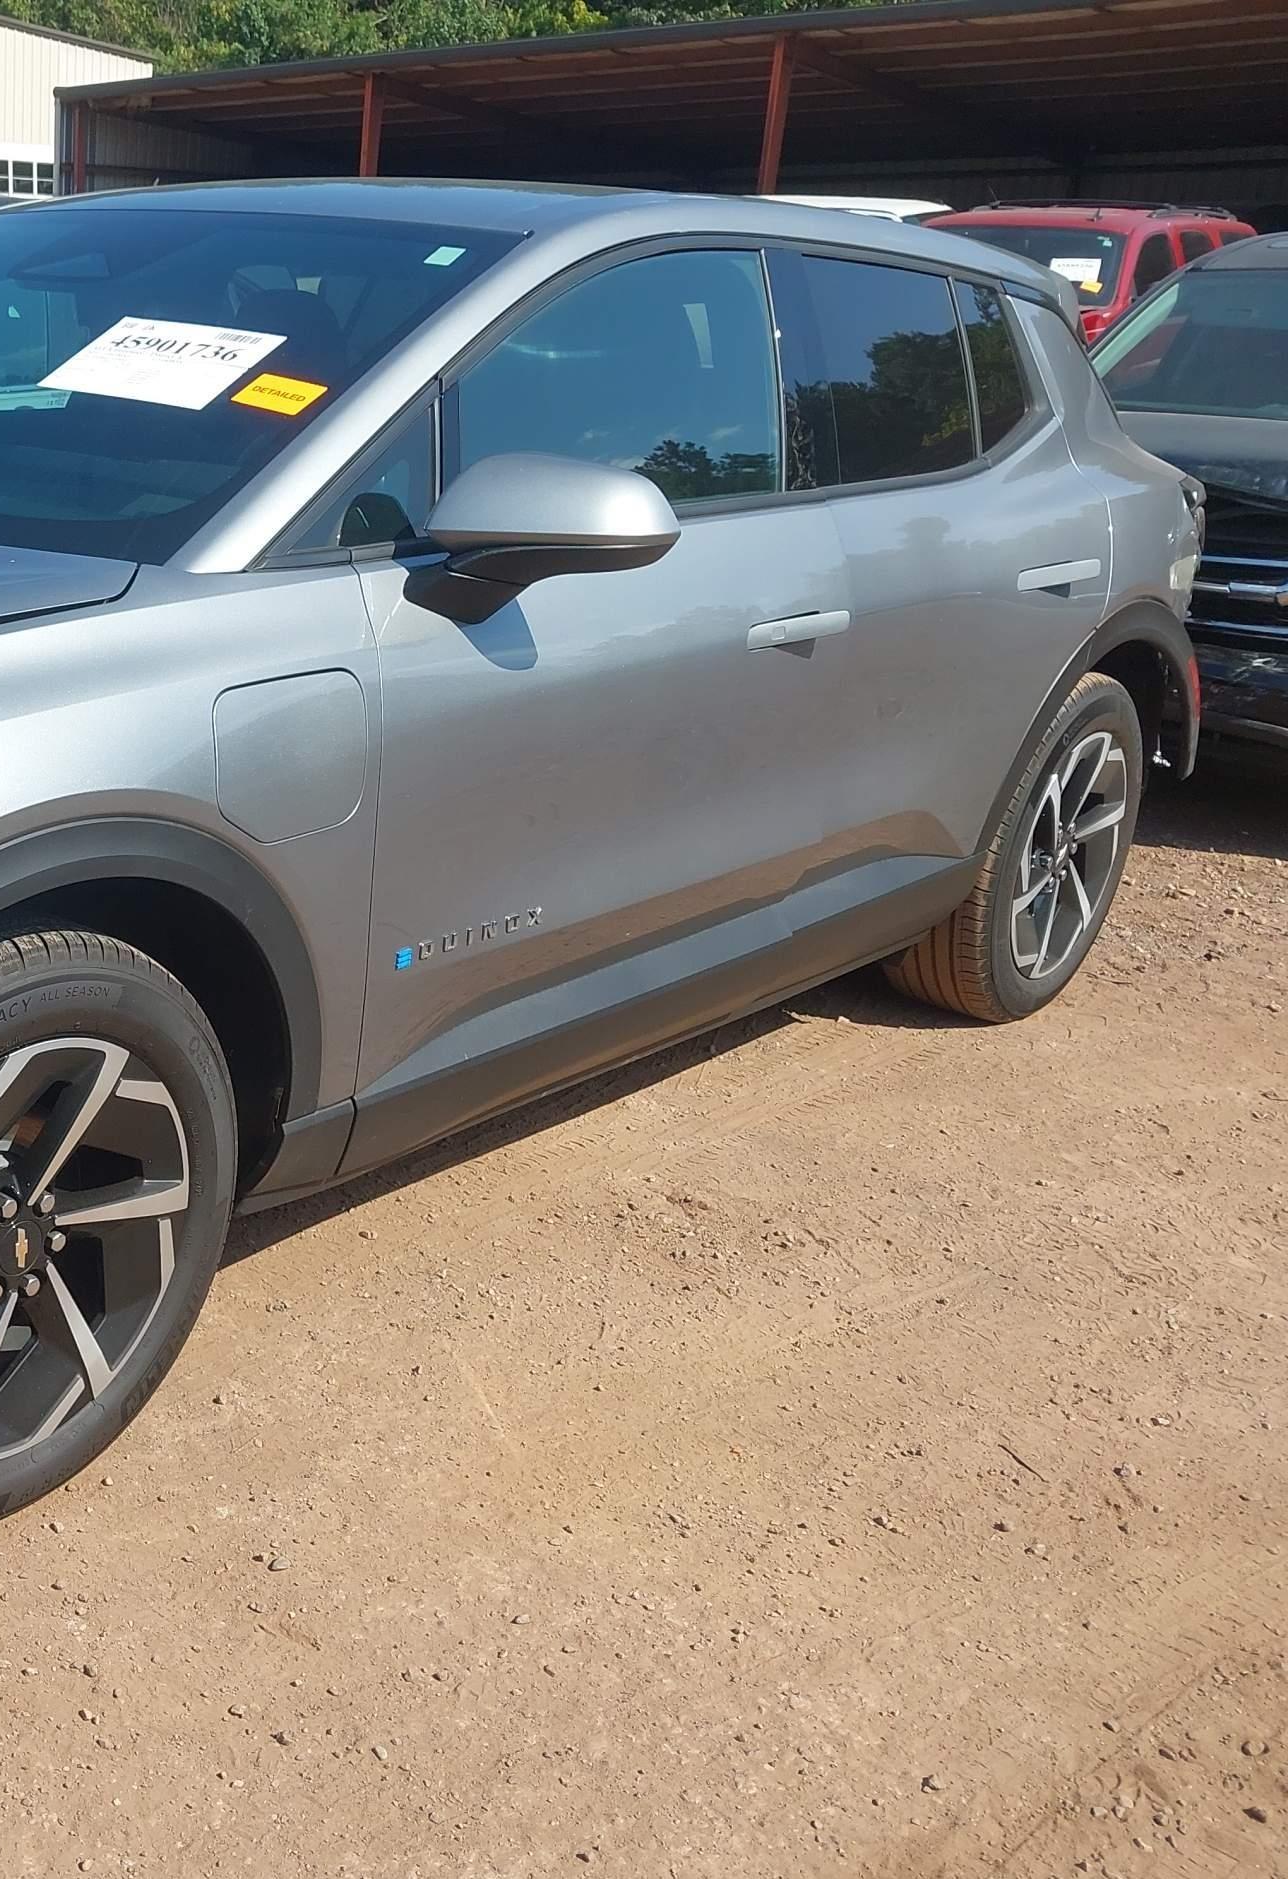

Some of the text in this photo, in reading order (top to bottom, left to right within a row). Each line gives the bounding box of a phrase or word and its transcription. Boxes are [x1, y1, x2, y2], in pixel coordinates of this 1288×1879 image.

[111, 334, 247, 362] 45901736
[252, 385, 306, 402] DETAILED
[395, 906, 543, 971] EQUINOX
[40, 987, 59, 1003] ALL
[65, 985, 111, 998] SEASON
